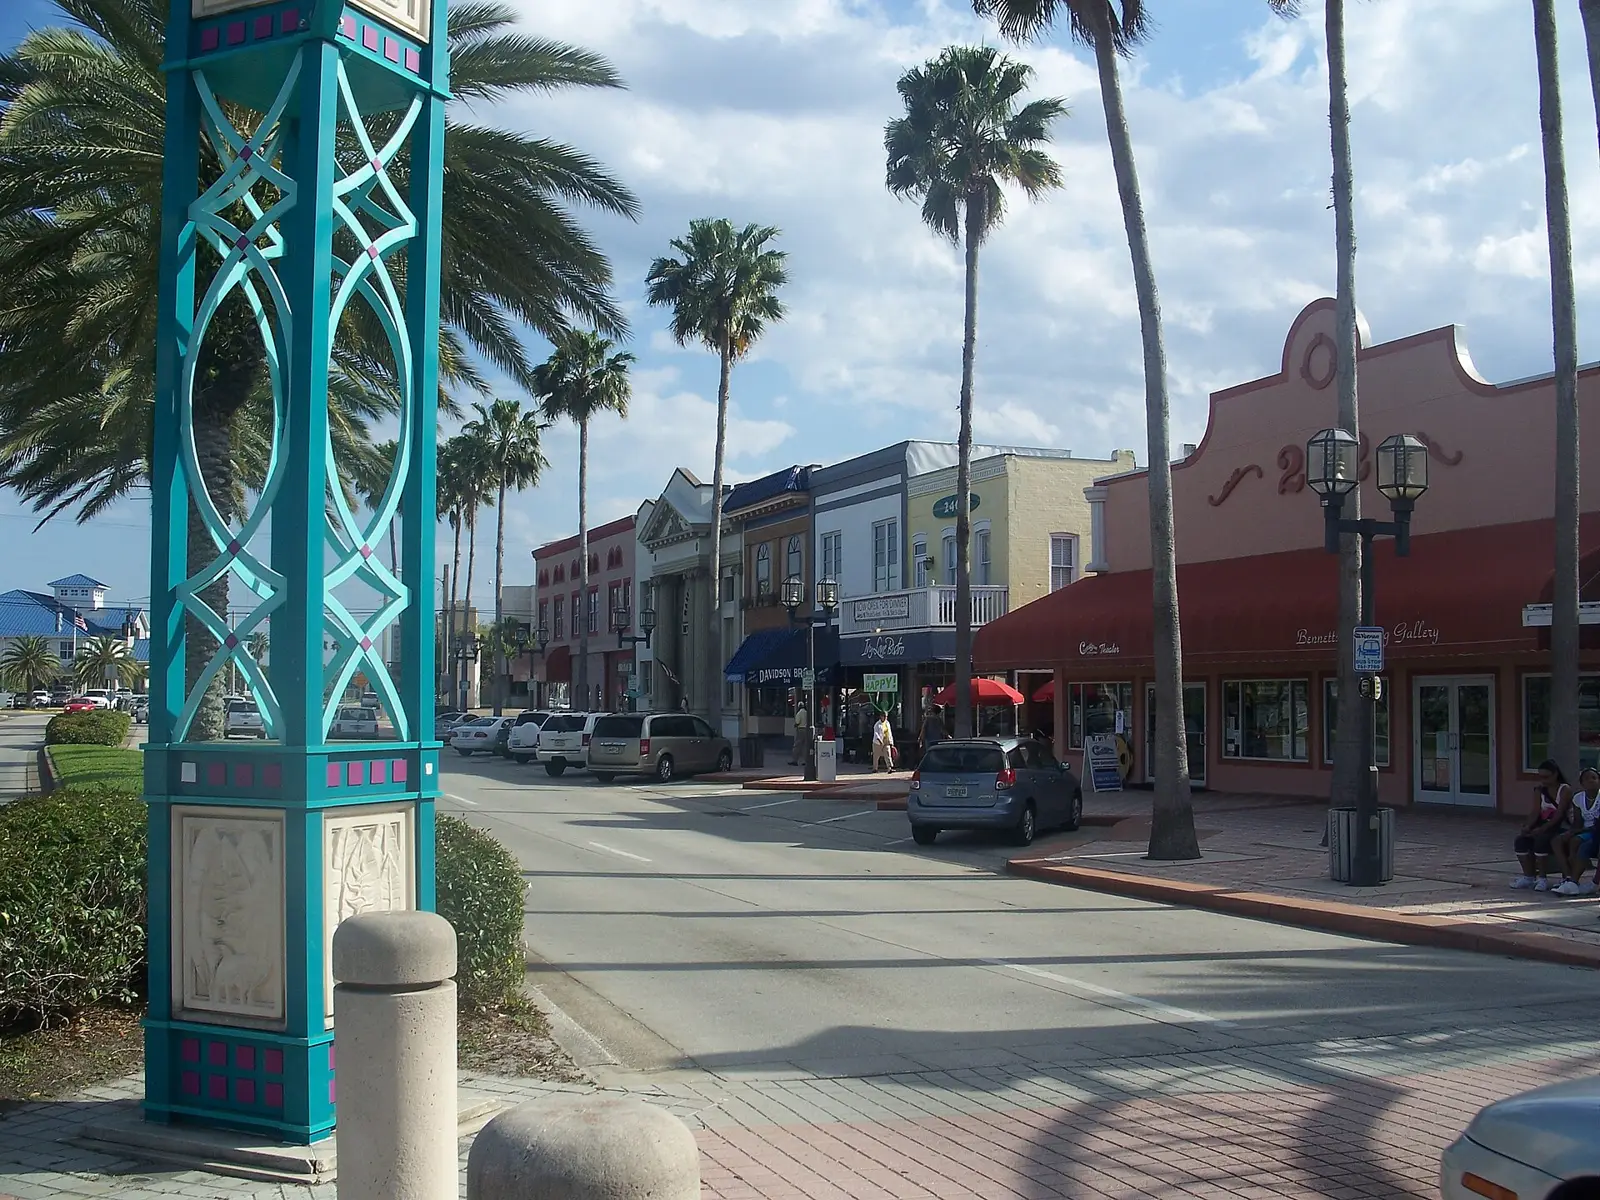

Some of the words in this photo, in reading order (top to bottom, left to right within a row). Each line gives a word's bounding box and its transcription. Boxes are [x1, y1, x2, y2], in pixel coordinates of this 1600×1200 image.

[1393, 620, 1439, 644] Gallery
[759, 668, 791, 683] DAVIDSON
[865, 675, 896, 690] HAPPY!
